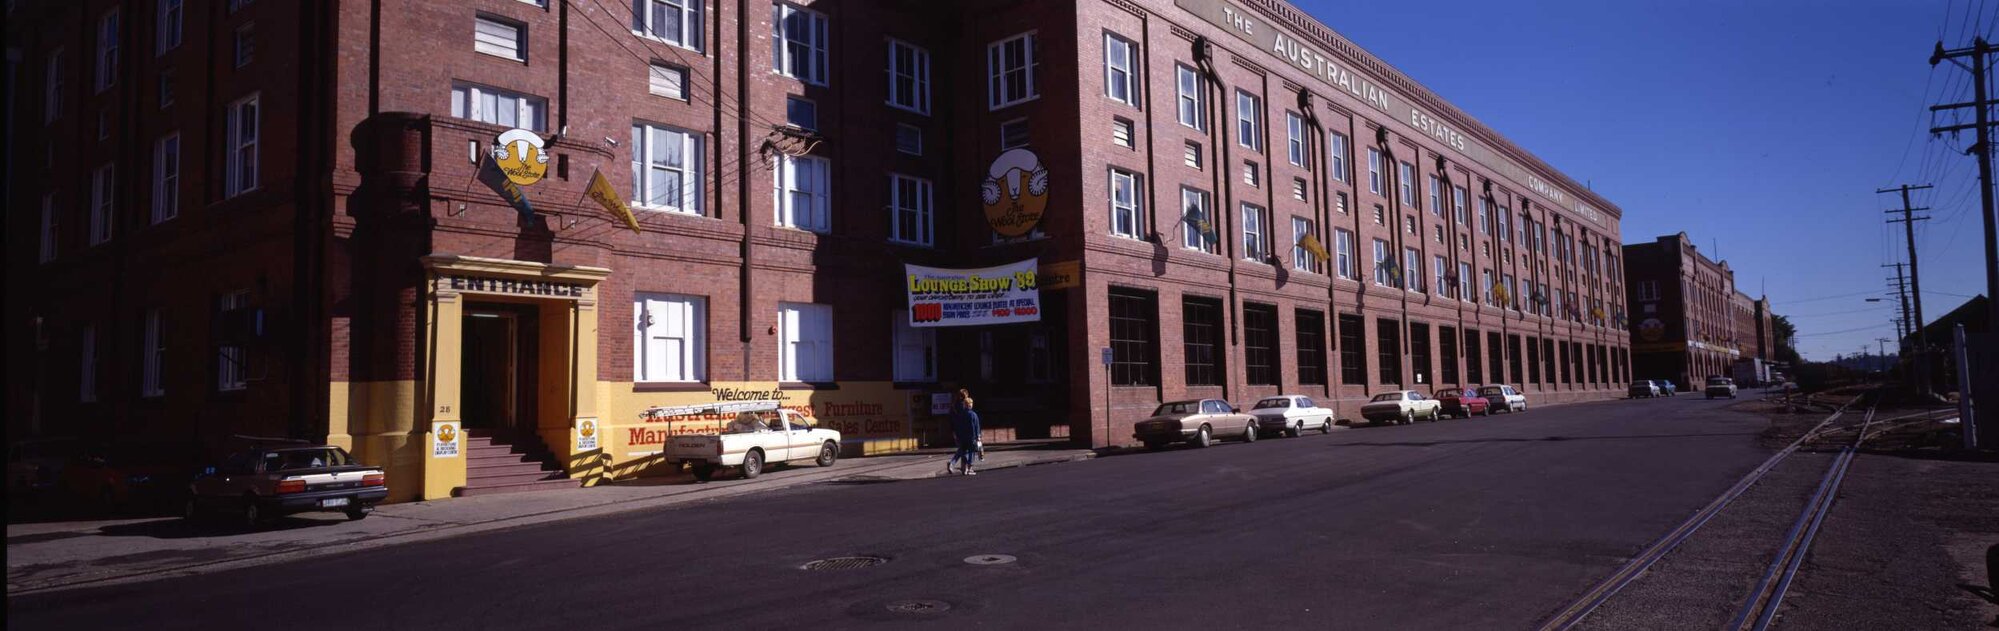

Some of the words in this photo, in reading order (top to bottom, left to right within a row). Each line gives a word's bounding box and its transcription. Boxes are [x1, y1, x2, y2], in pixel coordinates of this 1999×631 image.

[1223, 6, 1254, 36] THE
[1273, 33, 1388, 110] AUSTRALIAN
[1411, 108, 1465, 151] ESTATES
[1528, 174, 1563, 203] COMPANY
[1574, 200, 1598, 222] LIMITED
[450, 275, 583, 298] ENTRANCE
[909, 274, 969, 295] LOUNGE
[969, 274, 1012, 293] SHOW
[712, 388, 770, 401] Welcome
[823, 401, 883, 416] Furniture
[828, 419, 859, 435] Sales
[865, 419, 901, 433] Centre
